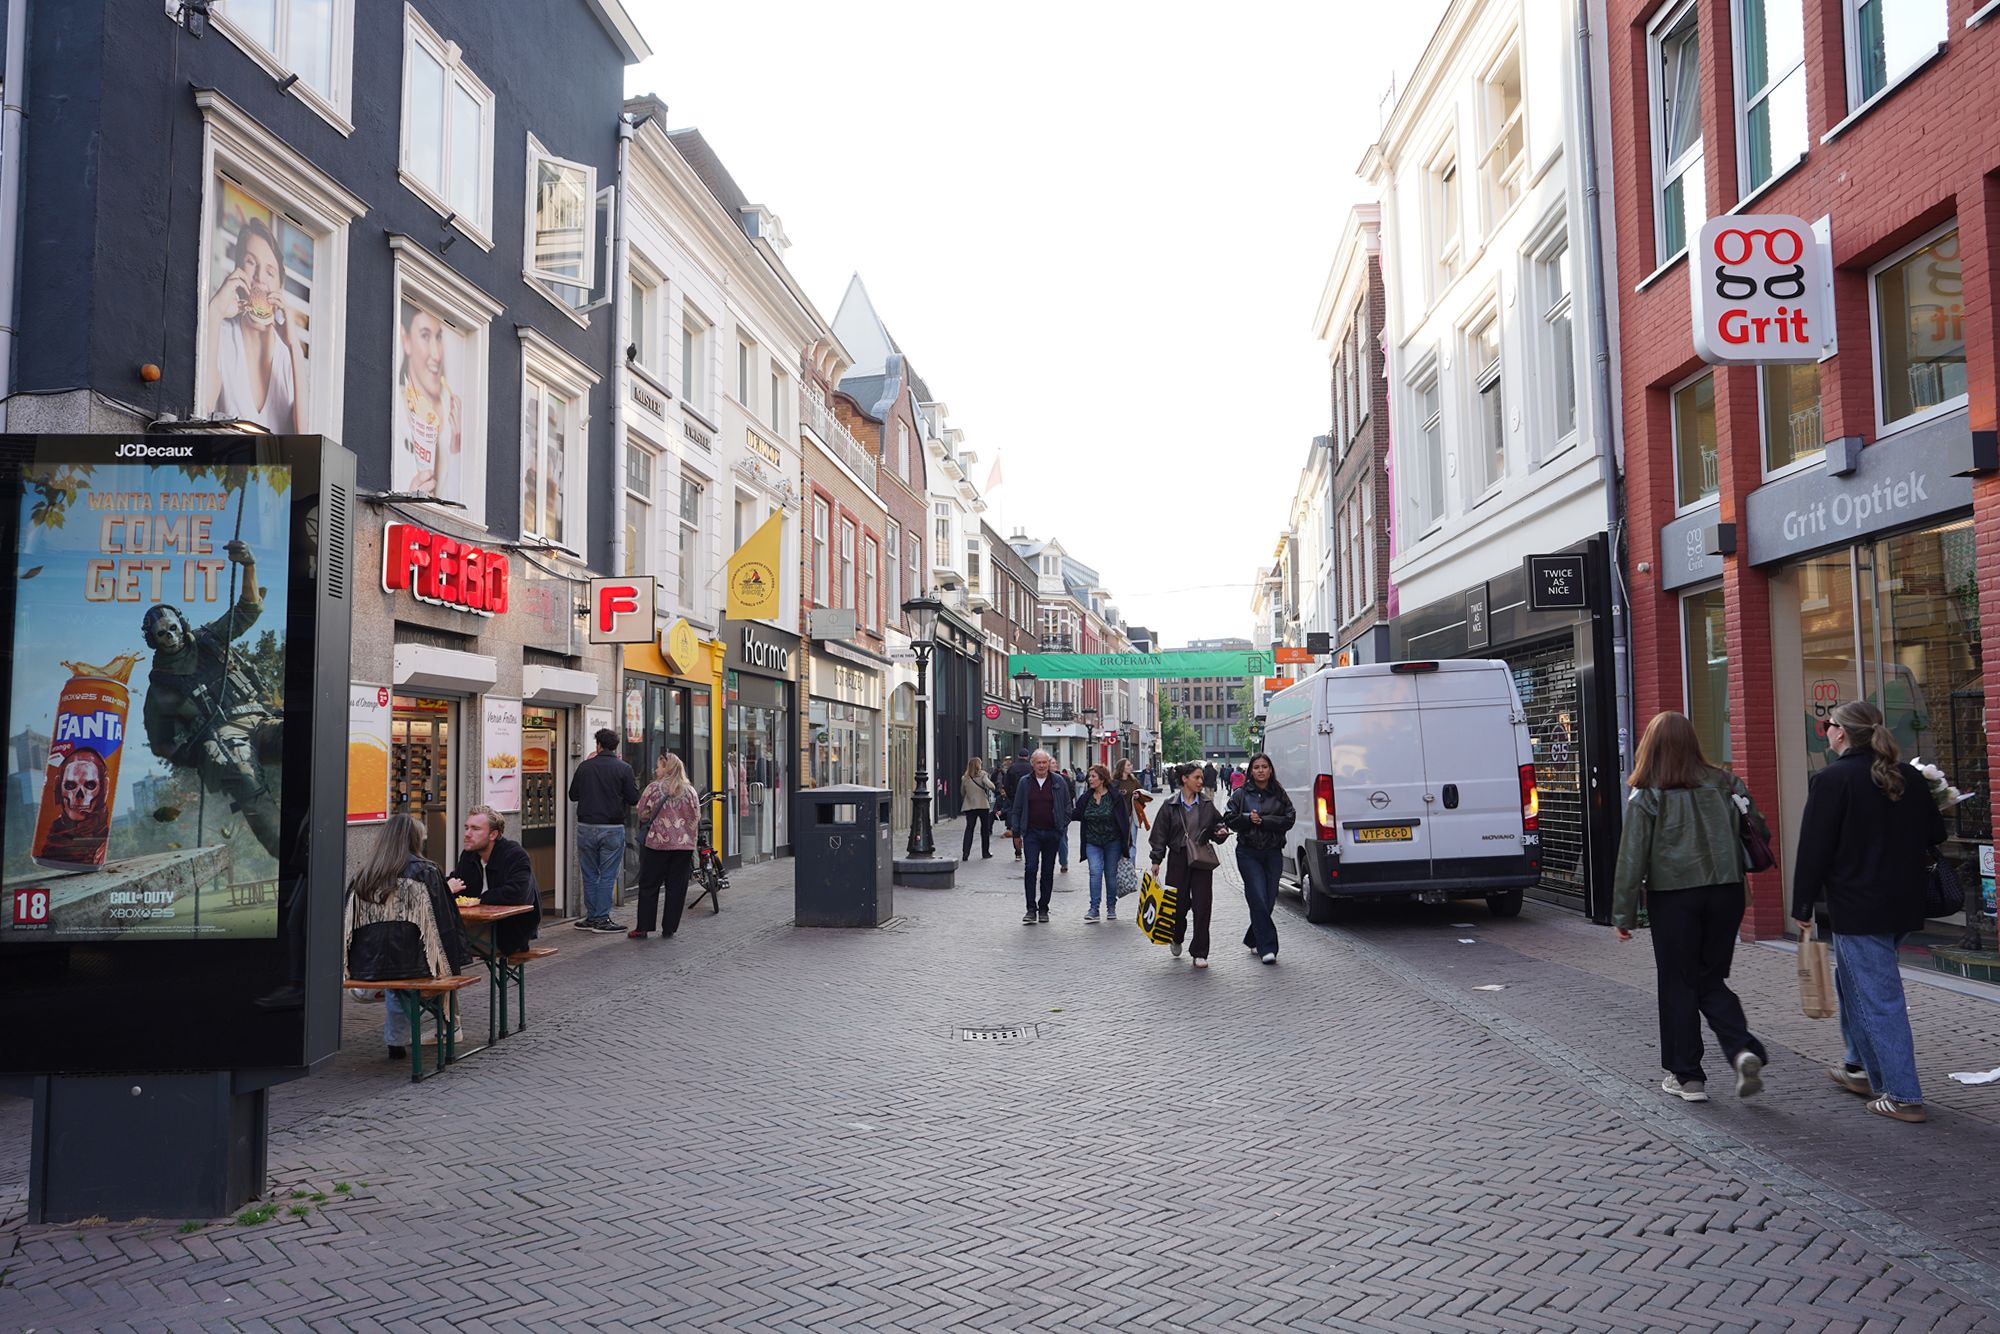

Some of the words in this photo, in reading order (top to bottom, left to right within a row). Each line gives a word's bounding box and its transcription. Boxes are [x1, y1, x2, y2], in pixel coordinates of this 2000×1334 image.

[1717, 305, 1810, 345] Grit
[115, 443, 194, 457] JCDecaux
[88, 492, 152, 511] WANTA
[159, 492, 228, 511] FANTA?
[1783, 501, 1826, 541] Grit
[1832, 470, 1928, 529] Optiek
[100, 514, 213, 555] COME
[383, 521, 509, 616] FEBO
[1687, 556, 1704, 571] Grit
[1543, 568, 1573, 578] TWICE
[85, 559, 171, 603] GET
[184, 559, 225, 603] IT
[1552, 578, 1565, 586] AS
[1548, 586, 1570, 595] NICE
[600, 585, 639, 633] F
[1470, 602, 1483, 613] TWICE
[1473, 612, 1480, 622] AS
[1472, 622, 1482, 632] NICE
[742, 626, 788, 672] Karma
[1100, 656, 1161, 666] BROEKMAN
[56, 711, 122, 740] FANTA
[110, 892, 136, 904] CALL
[144, 891, 174, 904] DUTY
[17, 892, 47, 920] 18
[110, 908, 141, 919] XBOX
[151, 908, 175, 918] 25
